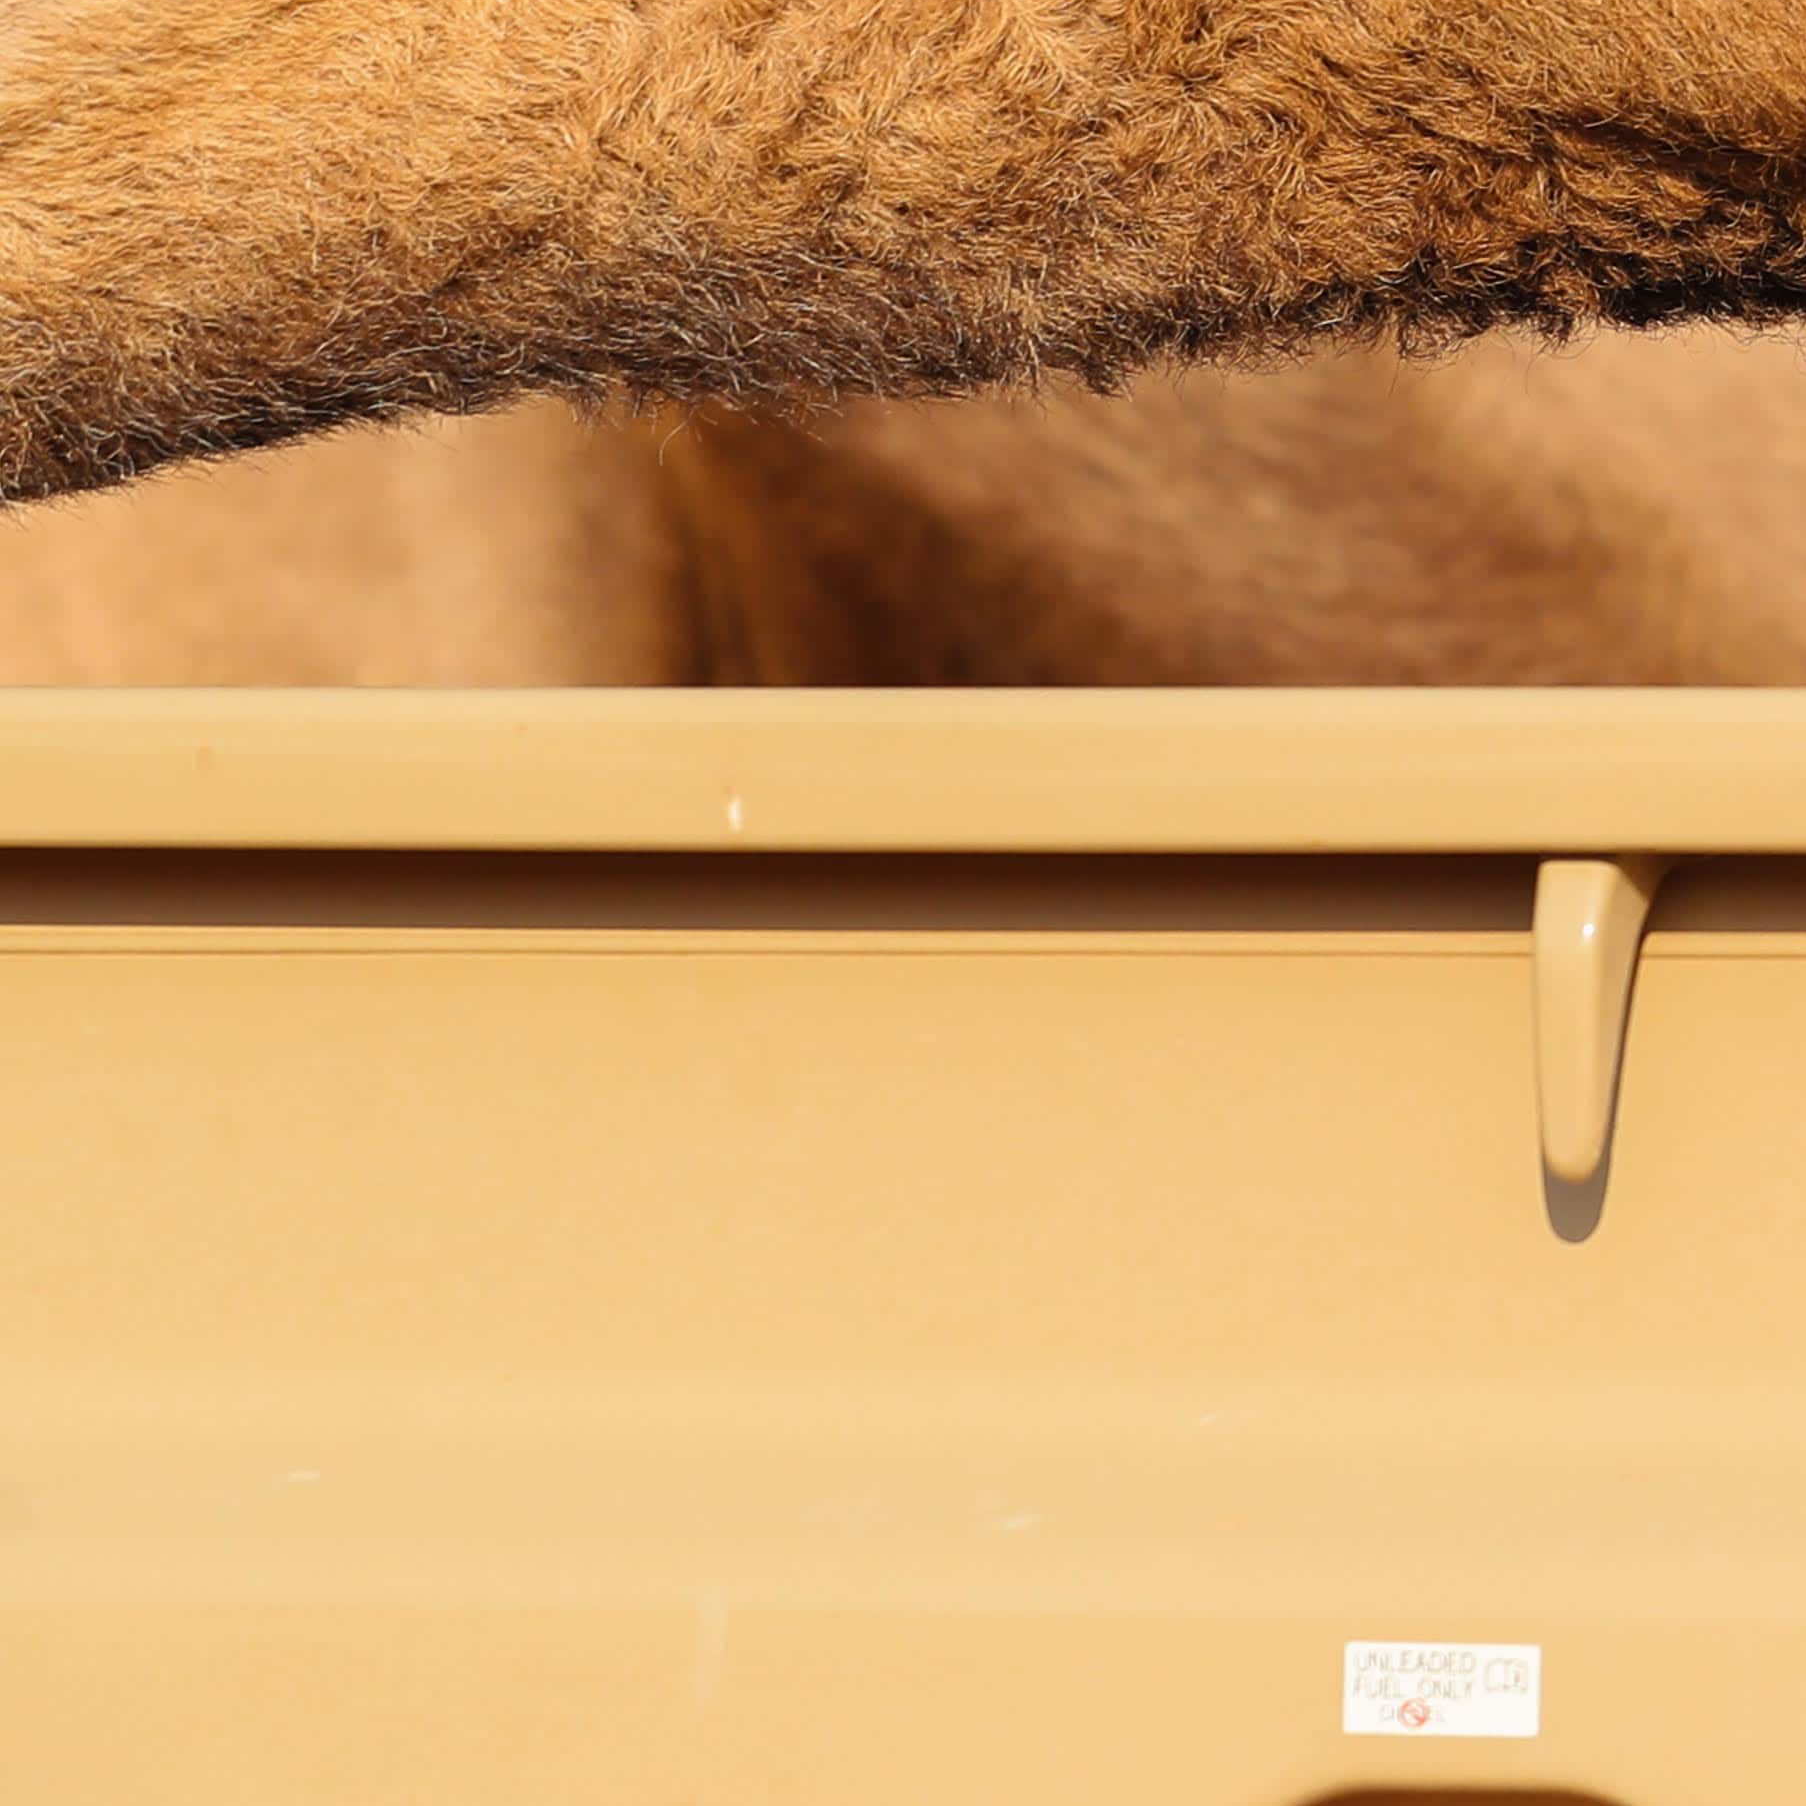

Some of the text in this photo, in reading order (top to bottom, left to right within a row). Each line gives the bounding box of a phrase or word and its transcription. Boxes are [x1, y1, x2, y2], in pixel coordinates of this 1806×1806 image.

[1352, 1650, 1477, 1674] UNLEADED
[1352, 1676, 1473, 1701] FUEL ONLY
